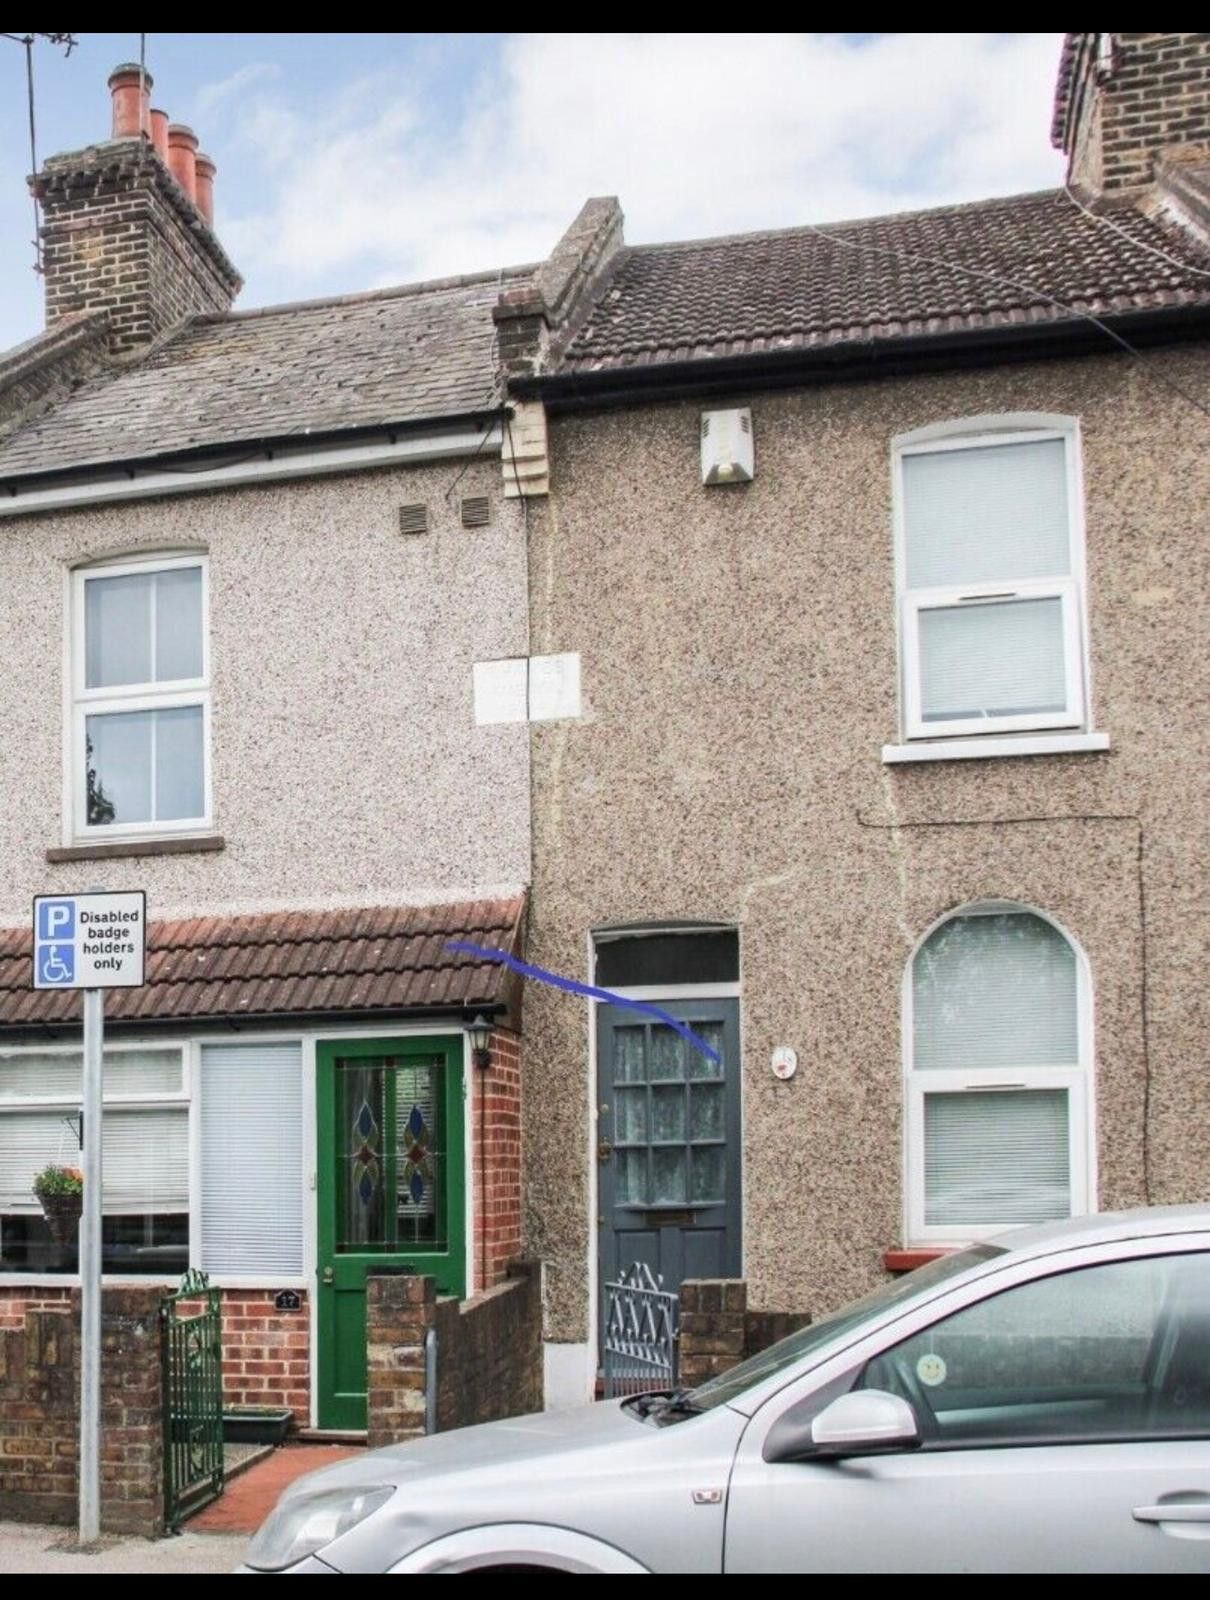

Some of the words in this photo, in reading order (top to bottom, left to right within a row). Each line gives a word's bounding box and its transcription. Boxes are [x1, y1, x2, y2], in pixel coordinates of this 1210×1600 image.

[48, 906, 70, 937] P
[80, 910, 139, 923] Disabled
[88, 927, 130, 940] badge
[83, 943, 134, 954] holders
[94, 957, 122, 971] only
